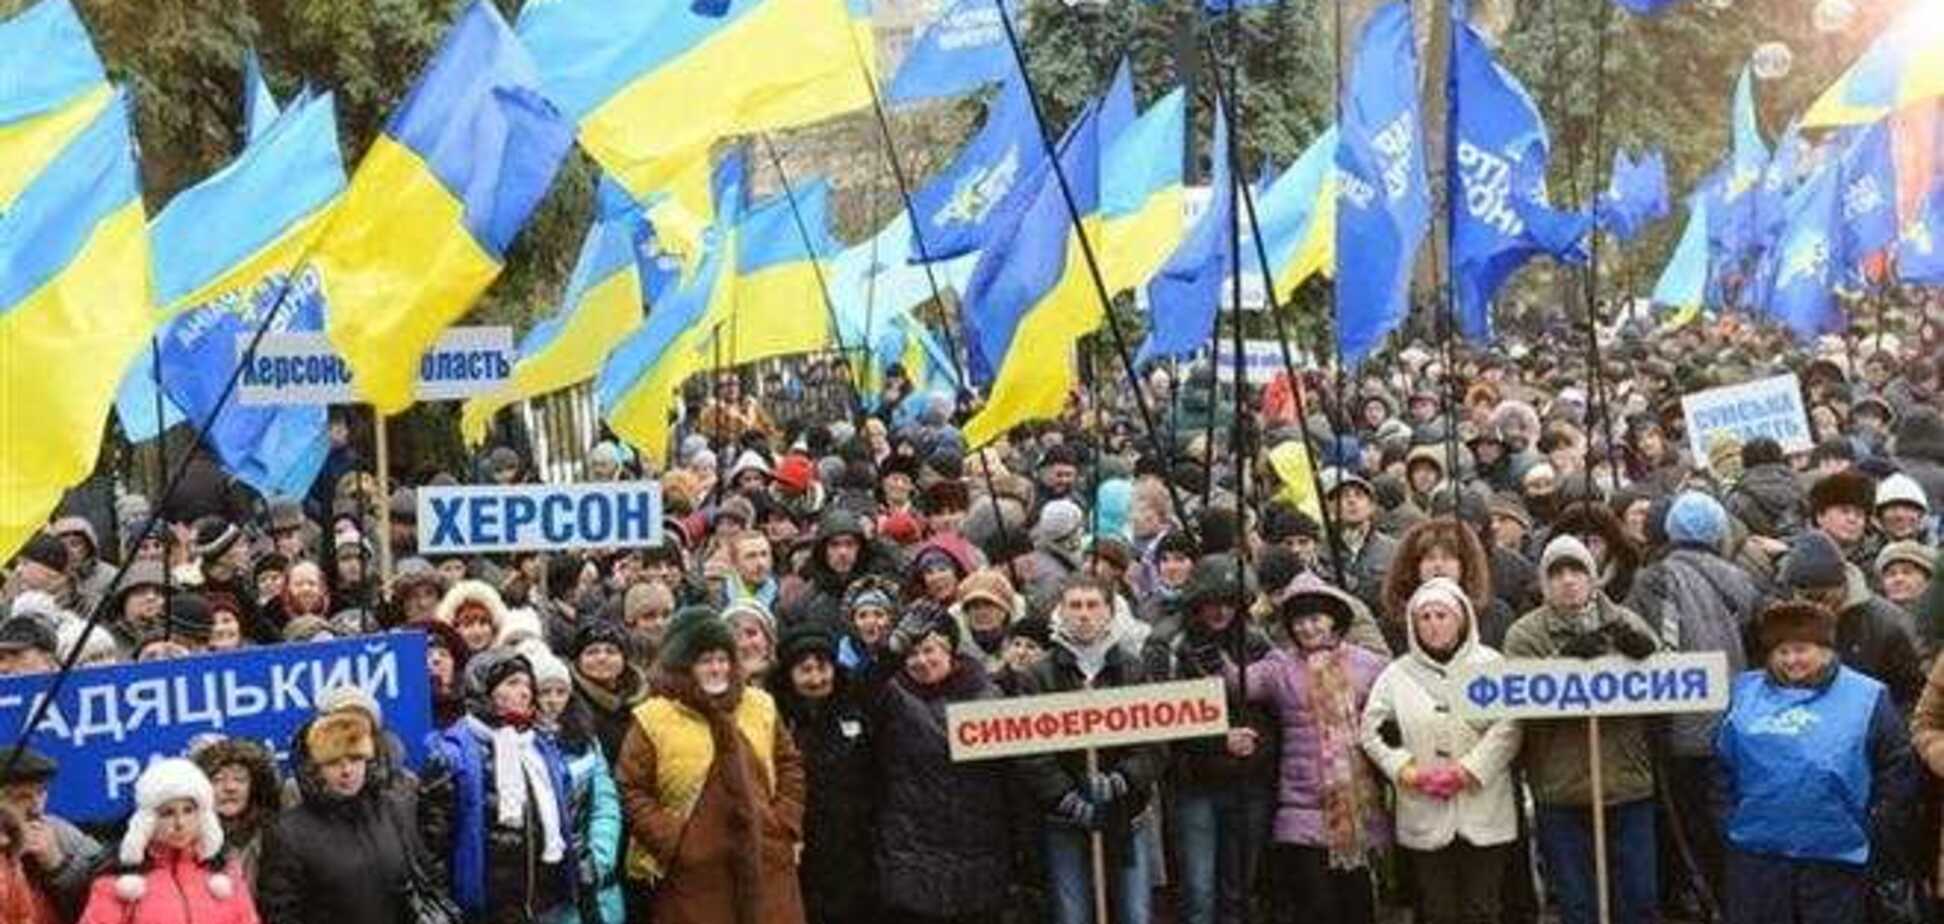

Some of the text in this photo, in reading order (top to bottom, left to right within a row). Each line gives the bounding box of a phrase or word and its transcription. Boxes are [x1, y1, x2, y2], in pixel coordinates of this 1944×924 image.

[241, 350, 353, 389] Херсонс
[429, 491, 650, 546] ХЕРСОН
[0, 641, 399, 746] АДЯЦЬКИЙ
[1466, 668, 1709, 711] ФЕОДОСИЯ
[957, 698, 1221, 747] СИМФЕРОПОЛЬ
